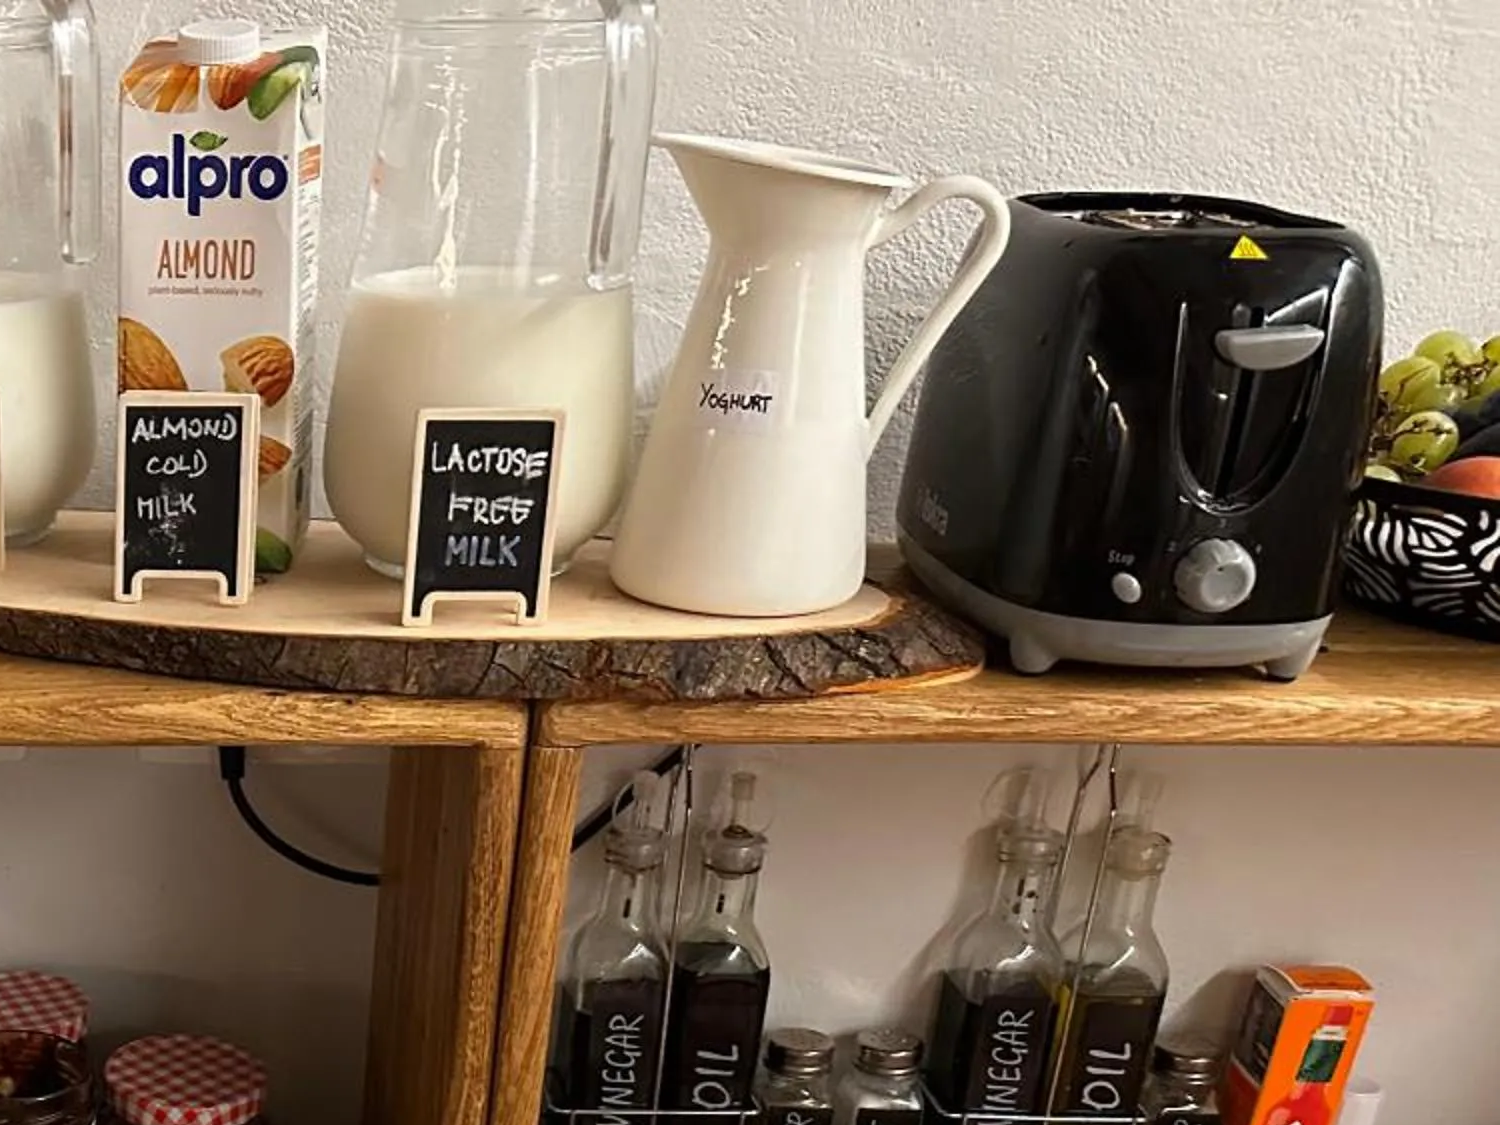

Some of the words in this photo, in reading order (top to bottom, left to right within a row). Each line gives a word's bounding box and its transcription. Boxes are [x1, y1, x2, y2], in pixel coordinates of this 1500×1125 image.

[128, 133, 289, 217] alpro
[157, 239, 257, 280] ALMOND
[699, 383, 773, 415] YOGHURT
[131, 413, 238, 443] ALMOND
[146, 449, 208, 478] COLD
[432, 440, 549, 479] LACTOSE
[137, 492, 197, 520] MILK
[447, 492, 536, 525] FREE
[445, 535, 521, 567] MILK
[1107, 549, 1136, 566] Stop
[691, 1044, 739, 1110] OIL
[1081, 1042, 1132, 1111] OIL
